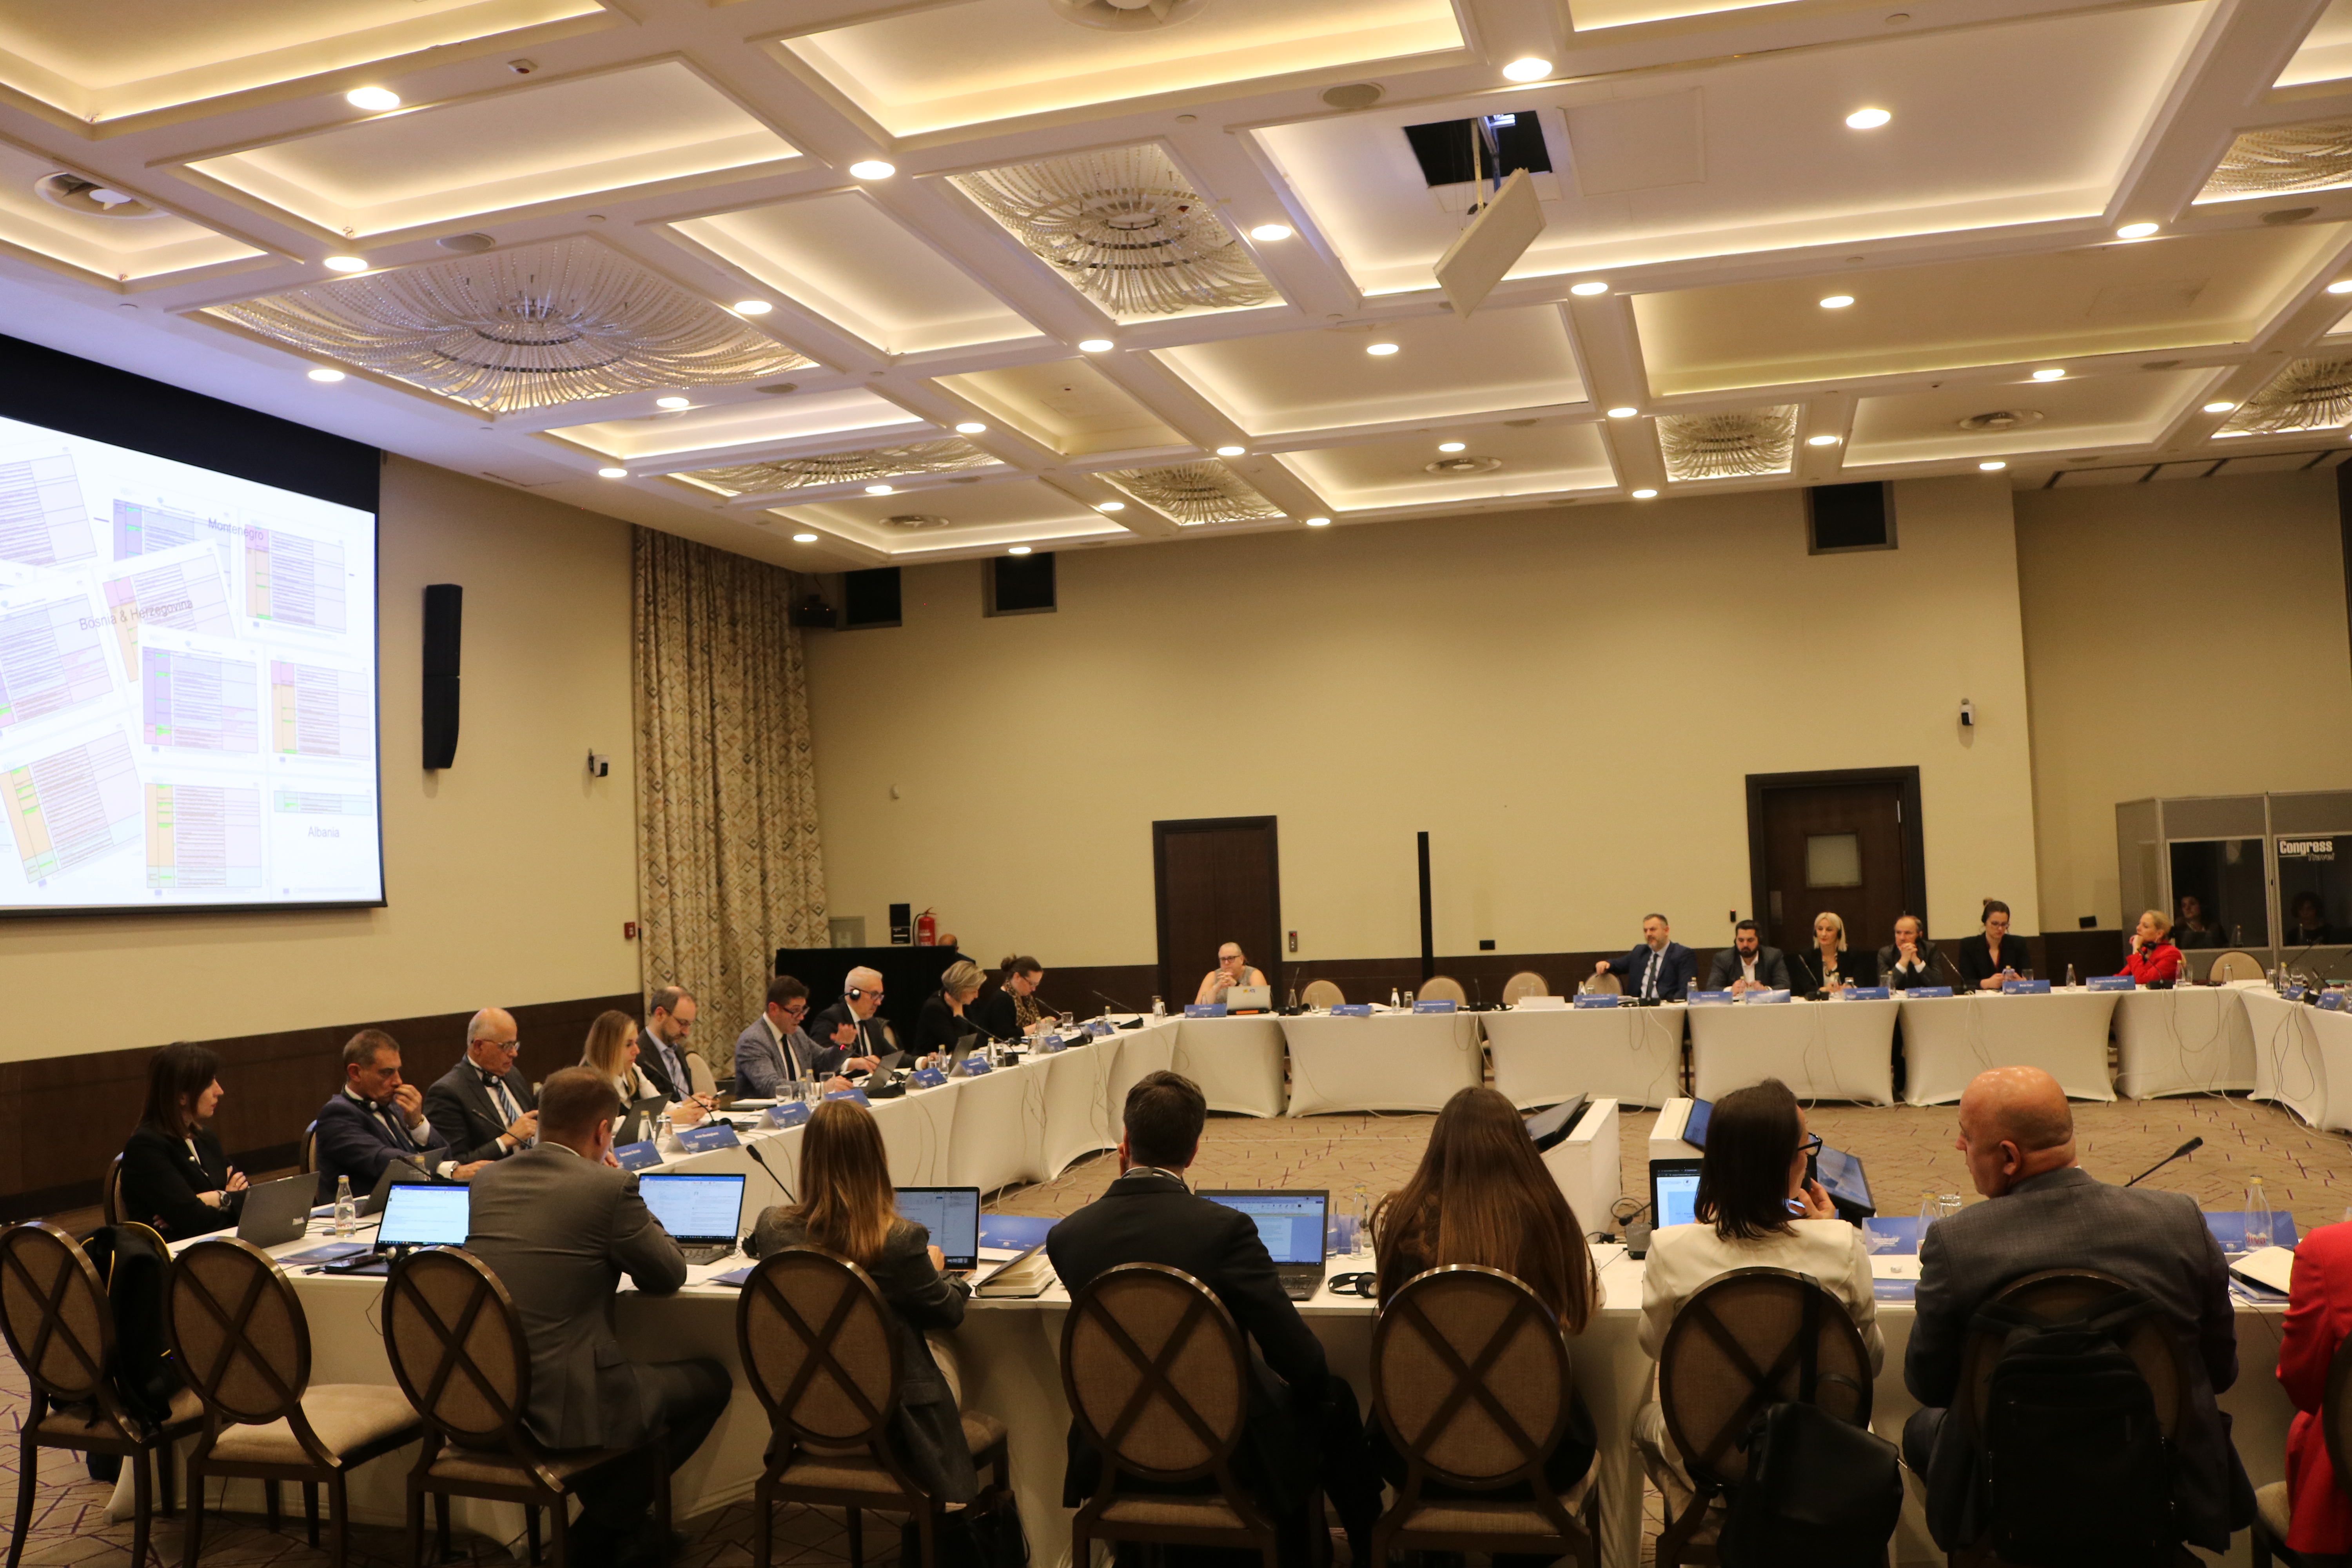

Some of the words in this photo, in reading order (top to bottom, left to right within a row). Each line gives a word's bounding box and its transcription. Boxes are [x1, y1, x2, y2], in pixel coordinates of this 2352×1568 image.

[208, 517, 263, 541] Montenegro
[79, 613, 116, 630] Bosnia
[120, 610, 128, 622] &
[130, 600, 193, 620] Herzegovina
[308, 826, 339, 837] Albania
[2279, 840, 2333, 857] Congress
